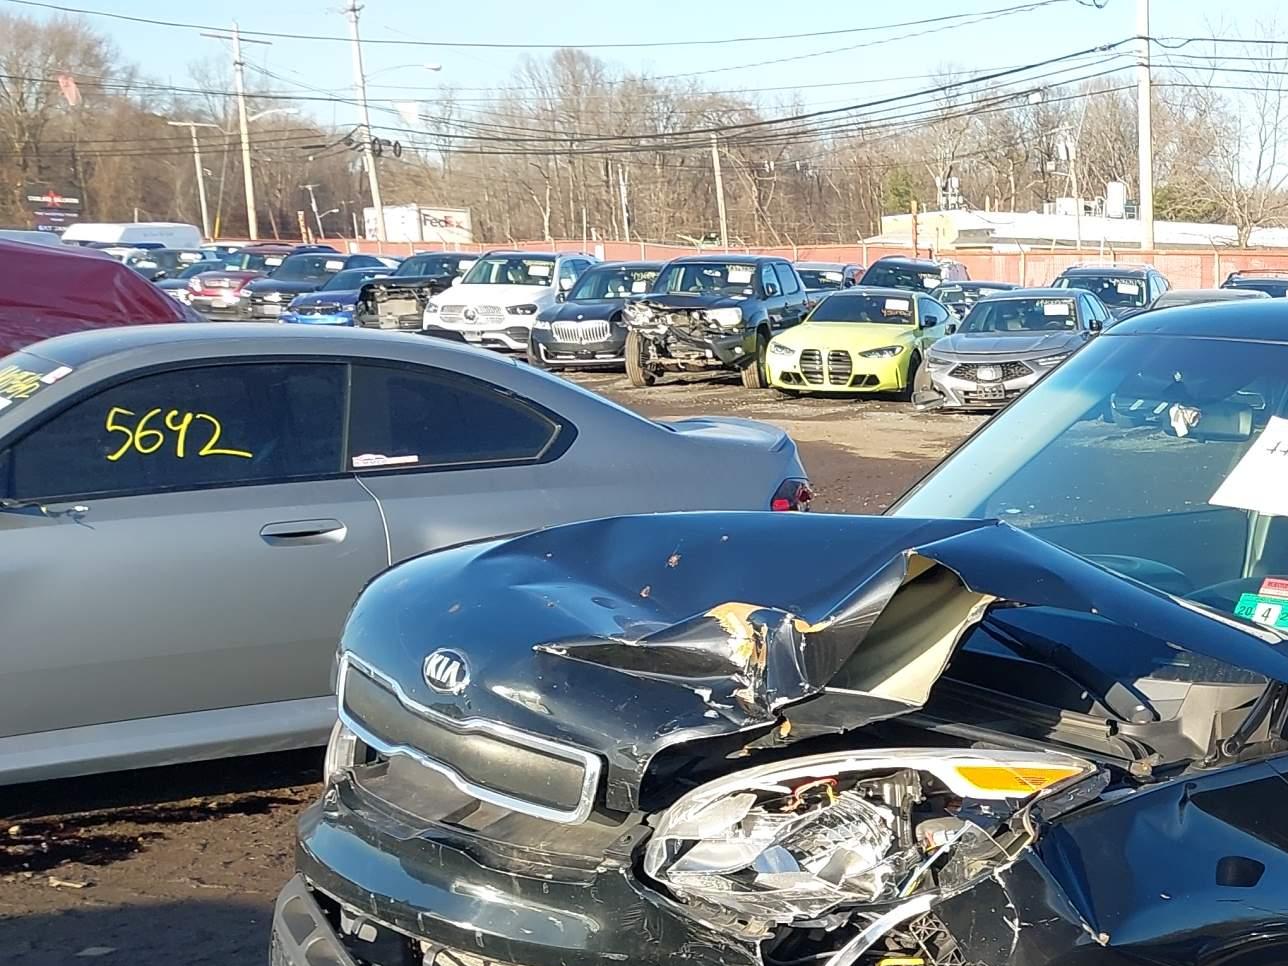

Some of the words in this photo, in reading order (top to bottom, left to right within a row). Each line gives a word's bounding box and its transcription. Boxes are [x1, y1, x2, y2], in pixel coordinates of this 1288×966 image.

[422, 213, 464, 229] FedEx
[1261, 607, 1272, 622] 4
[426, 653, 461, 688] KIA
